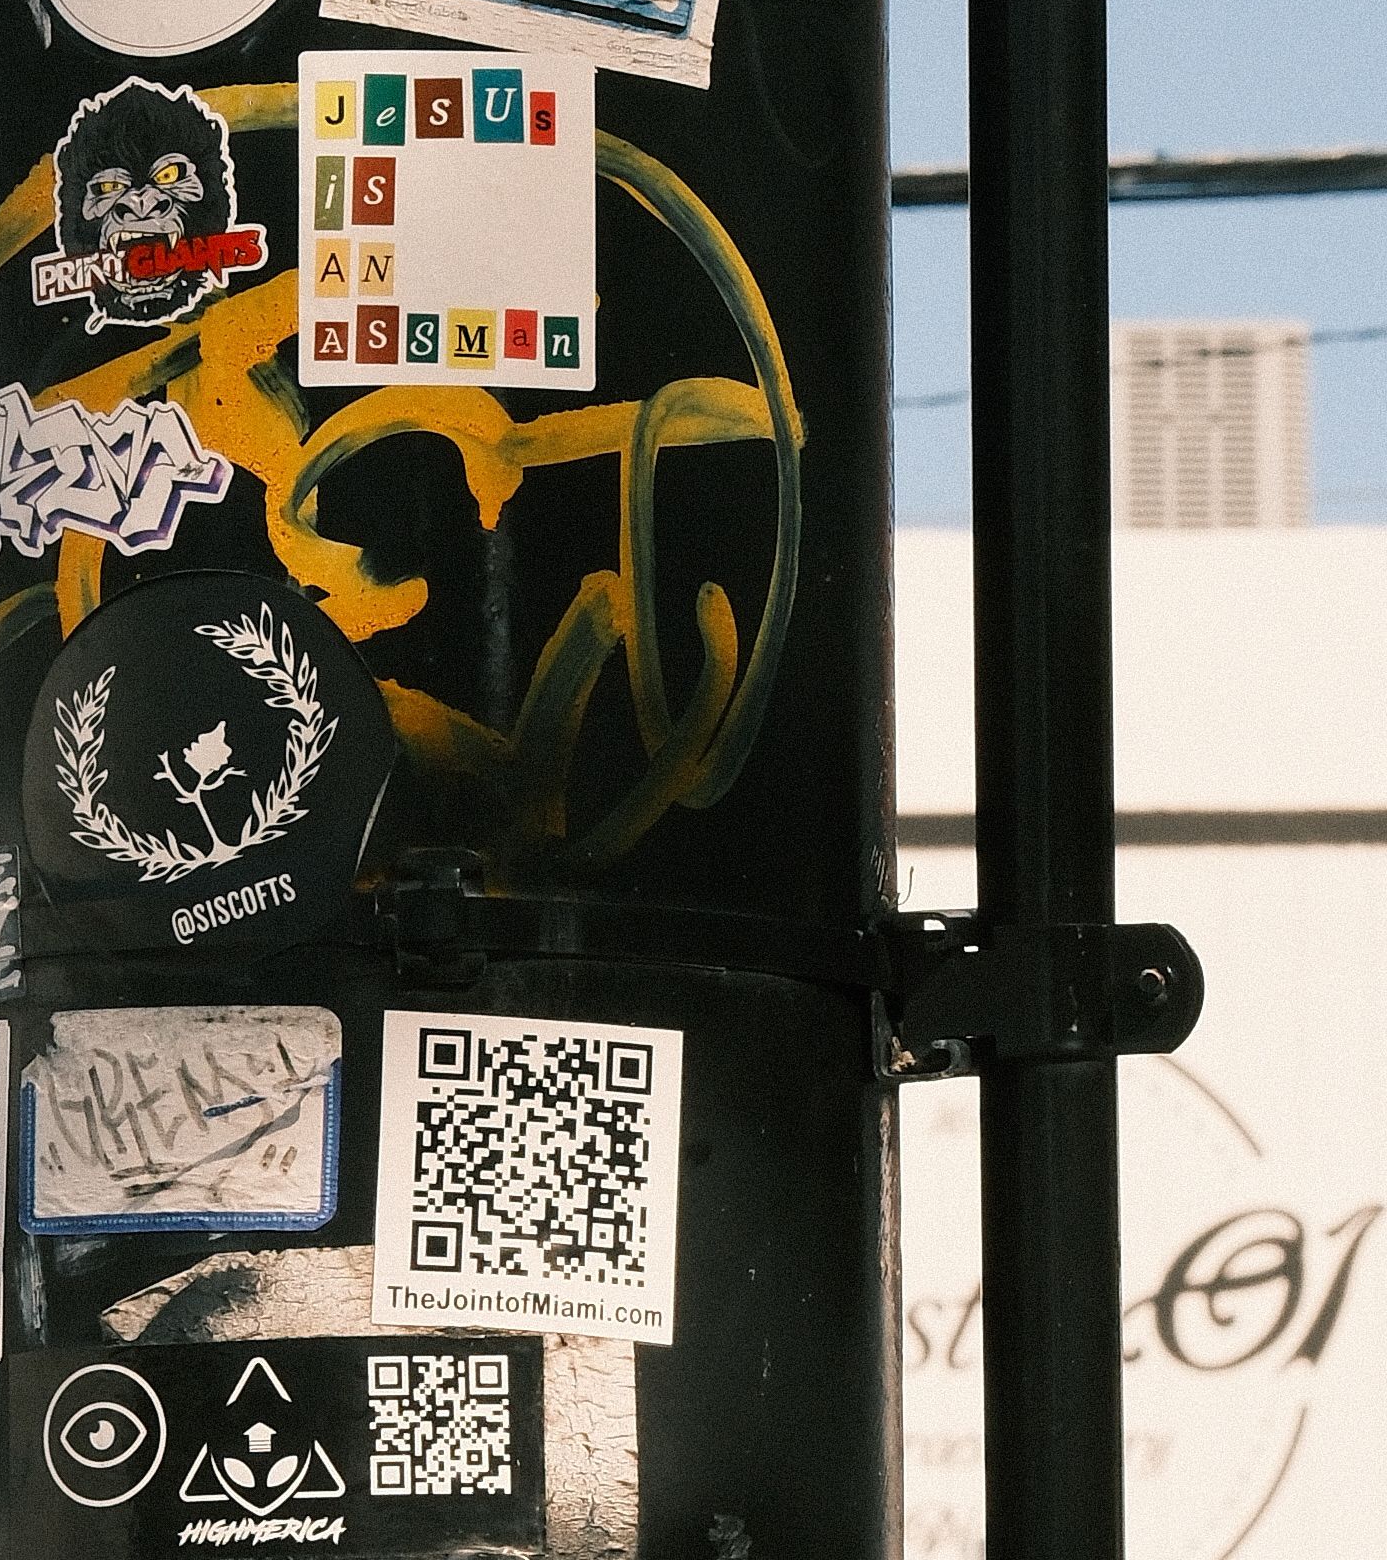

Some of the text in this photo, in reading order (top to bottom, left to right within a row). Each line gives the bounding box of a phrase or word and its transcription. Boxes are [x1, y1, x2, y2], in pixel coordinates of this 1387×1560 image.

[320, 252, 394, 283] AN
[171, 873, 297, 945] @SISCOFTS
[386, 1285, 663, 1328] TheJointofMiami.com
[177, 1515, 348, 1547] HIGHMERICA
